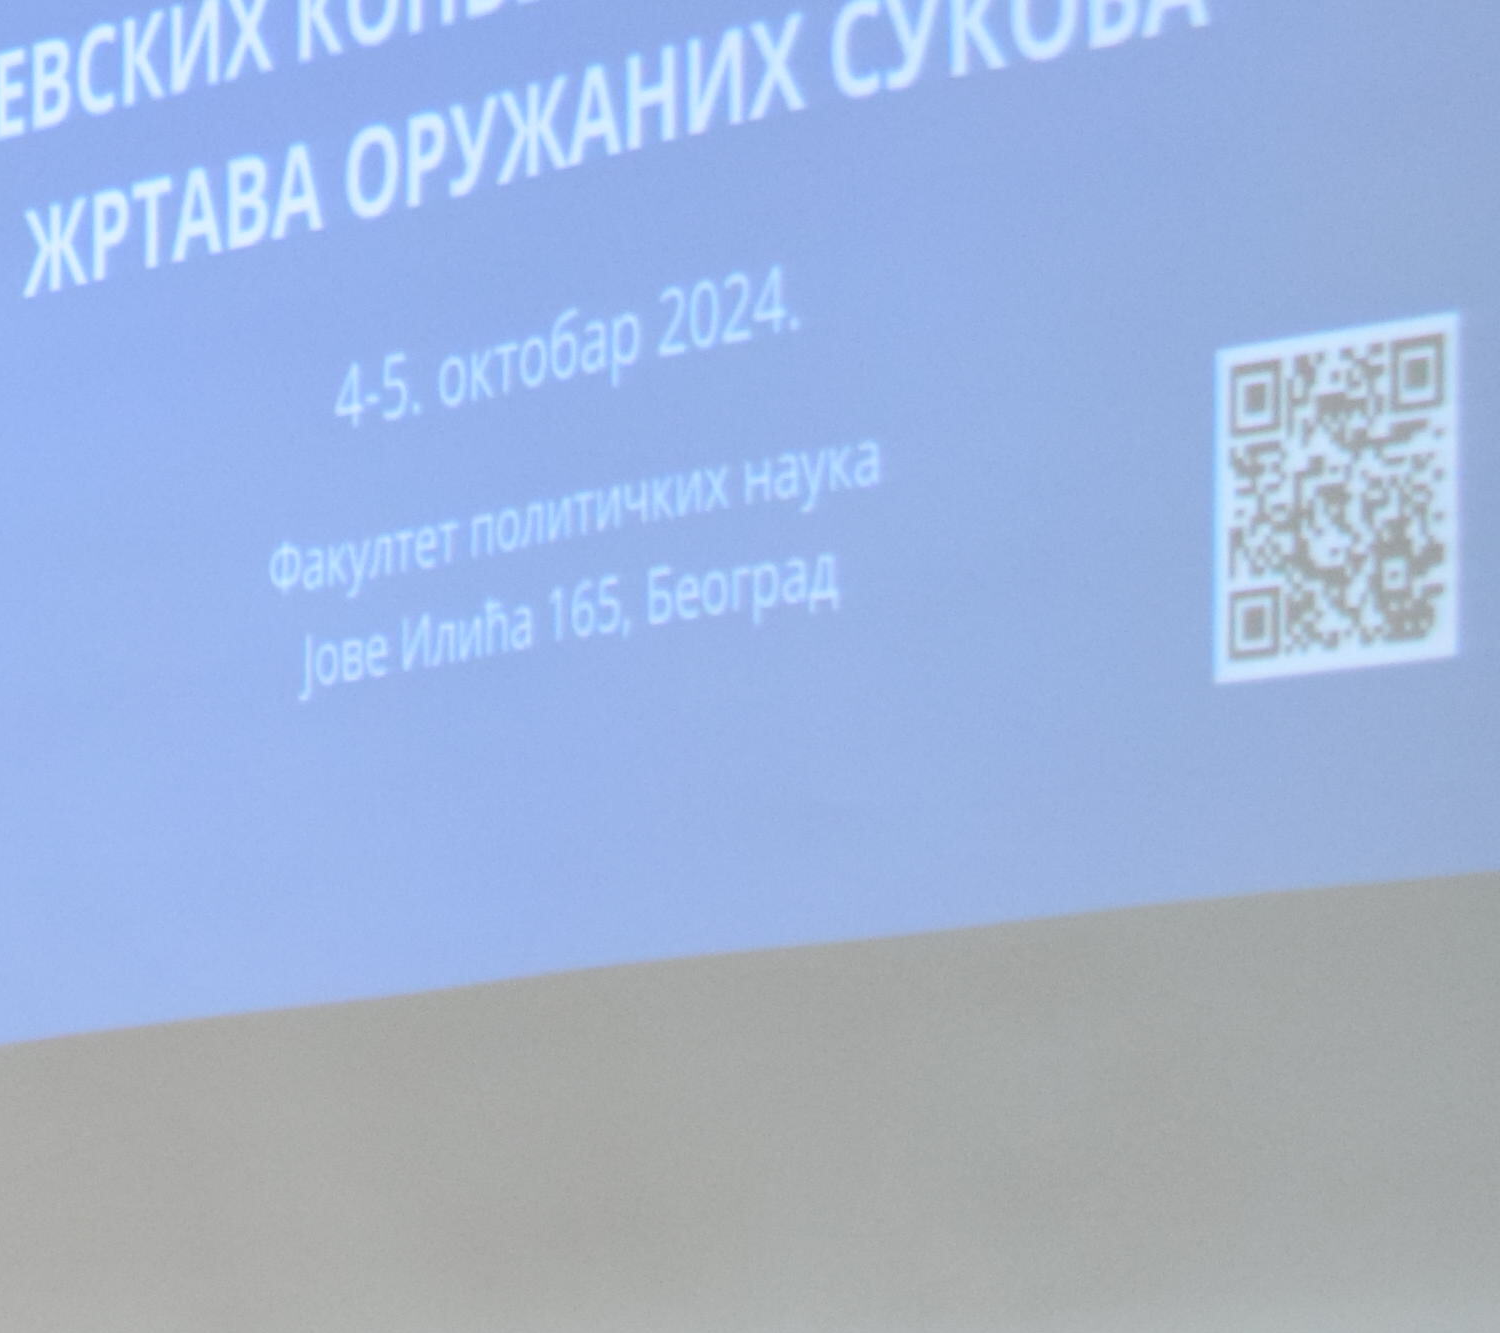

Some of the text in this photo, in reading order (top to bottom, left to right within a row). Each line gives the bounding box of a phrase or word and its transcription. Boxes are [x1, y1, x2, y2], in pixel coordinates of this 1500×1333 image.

[22, 142, 325, 299] ЖРТАВА
[344, 9, 808, 221] ОРУЖАНИХ
[333, 263, 802, 428] 4-5. октобар 2024.
[268, 438, 883, 600] Факултет политичких наука
[299, 551, 844, 702] Јове Илића 165, Београд
